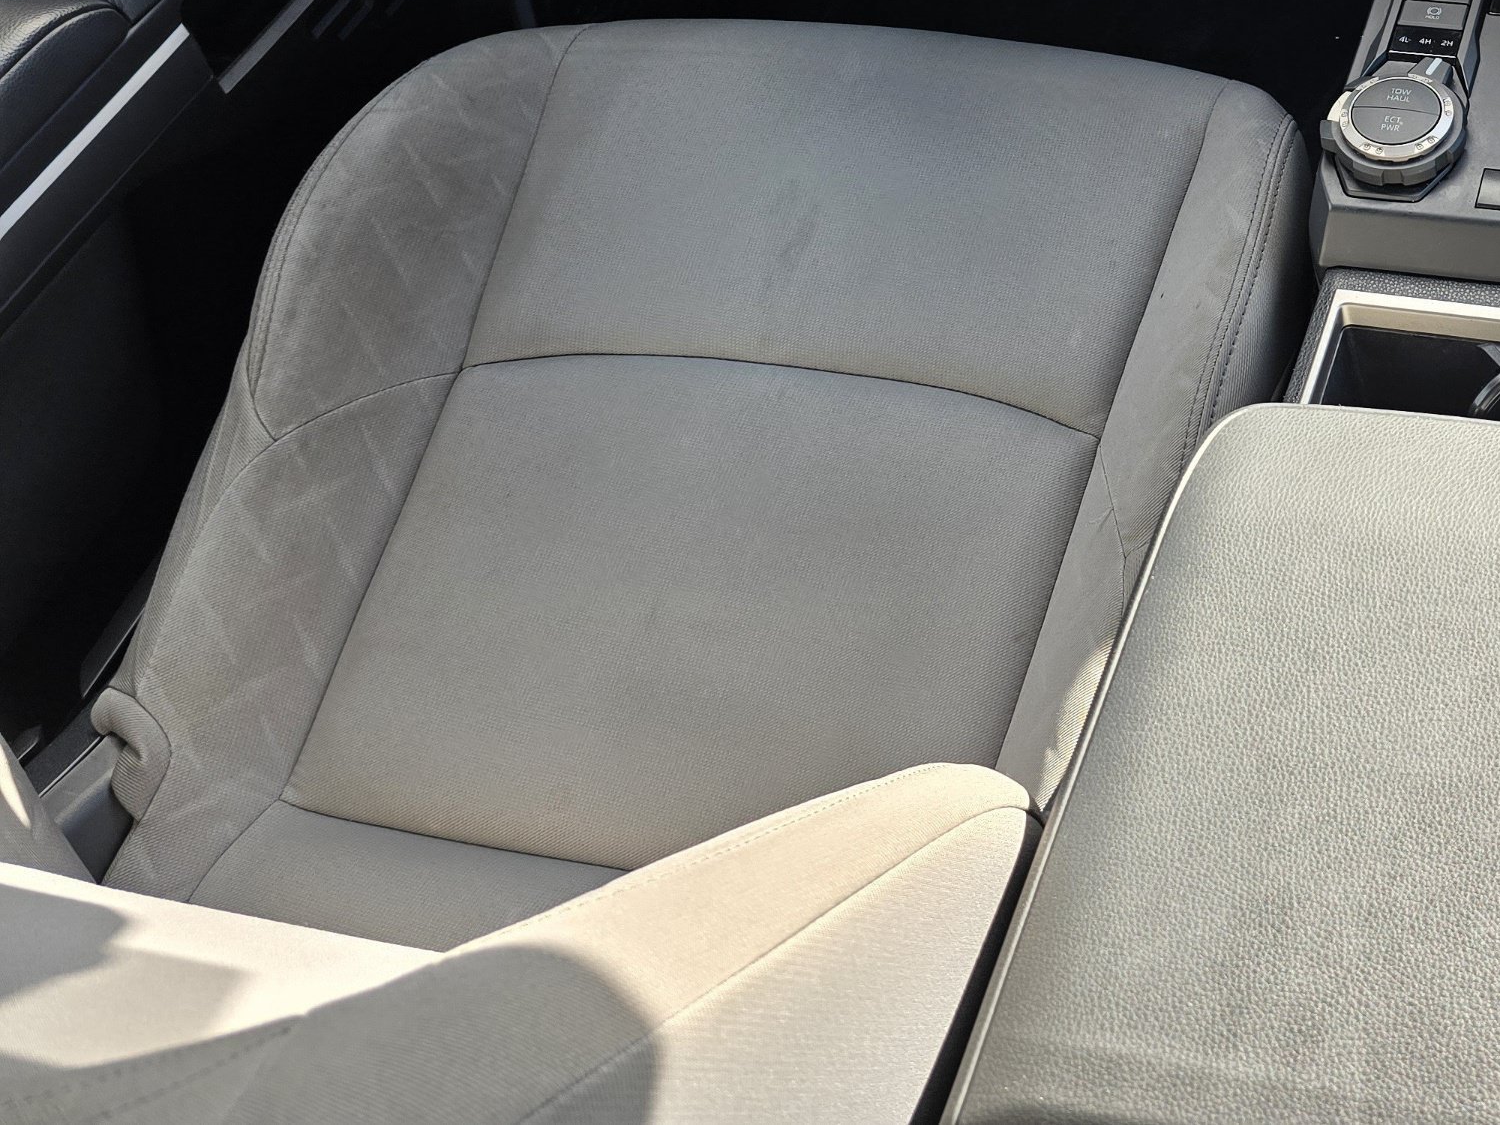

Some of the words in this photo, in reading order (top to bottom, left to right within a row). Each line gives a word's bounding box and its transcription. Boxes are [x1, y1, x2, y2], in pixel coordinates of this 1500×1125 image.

[1419, 37, 1432, 45] 4H
[1441, 39, 1454, 47] 2H
[1387, 95, 1410, 103] HAUL
[1381, 124, 1400, 132] PWR
